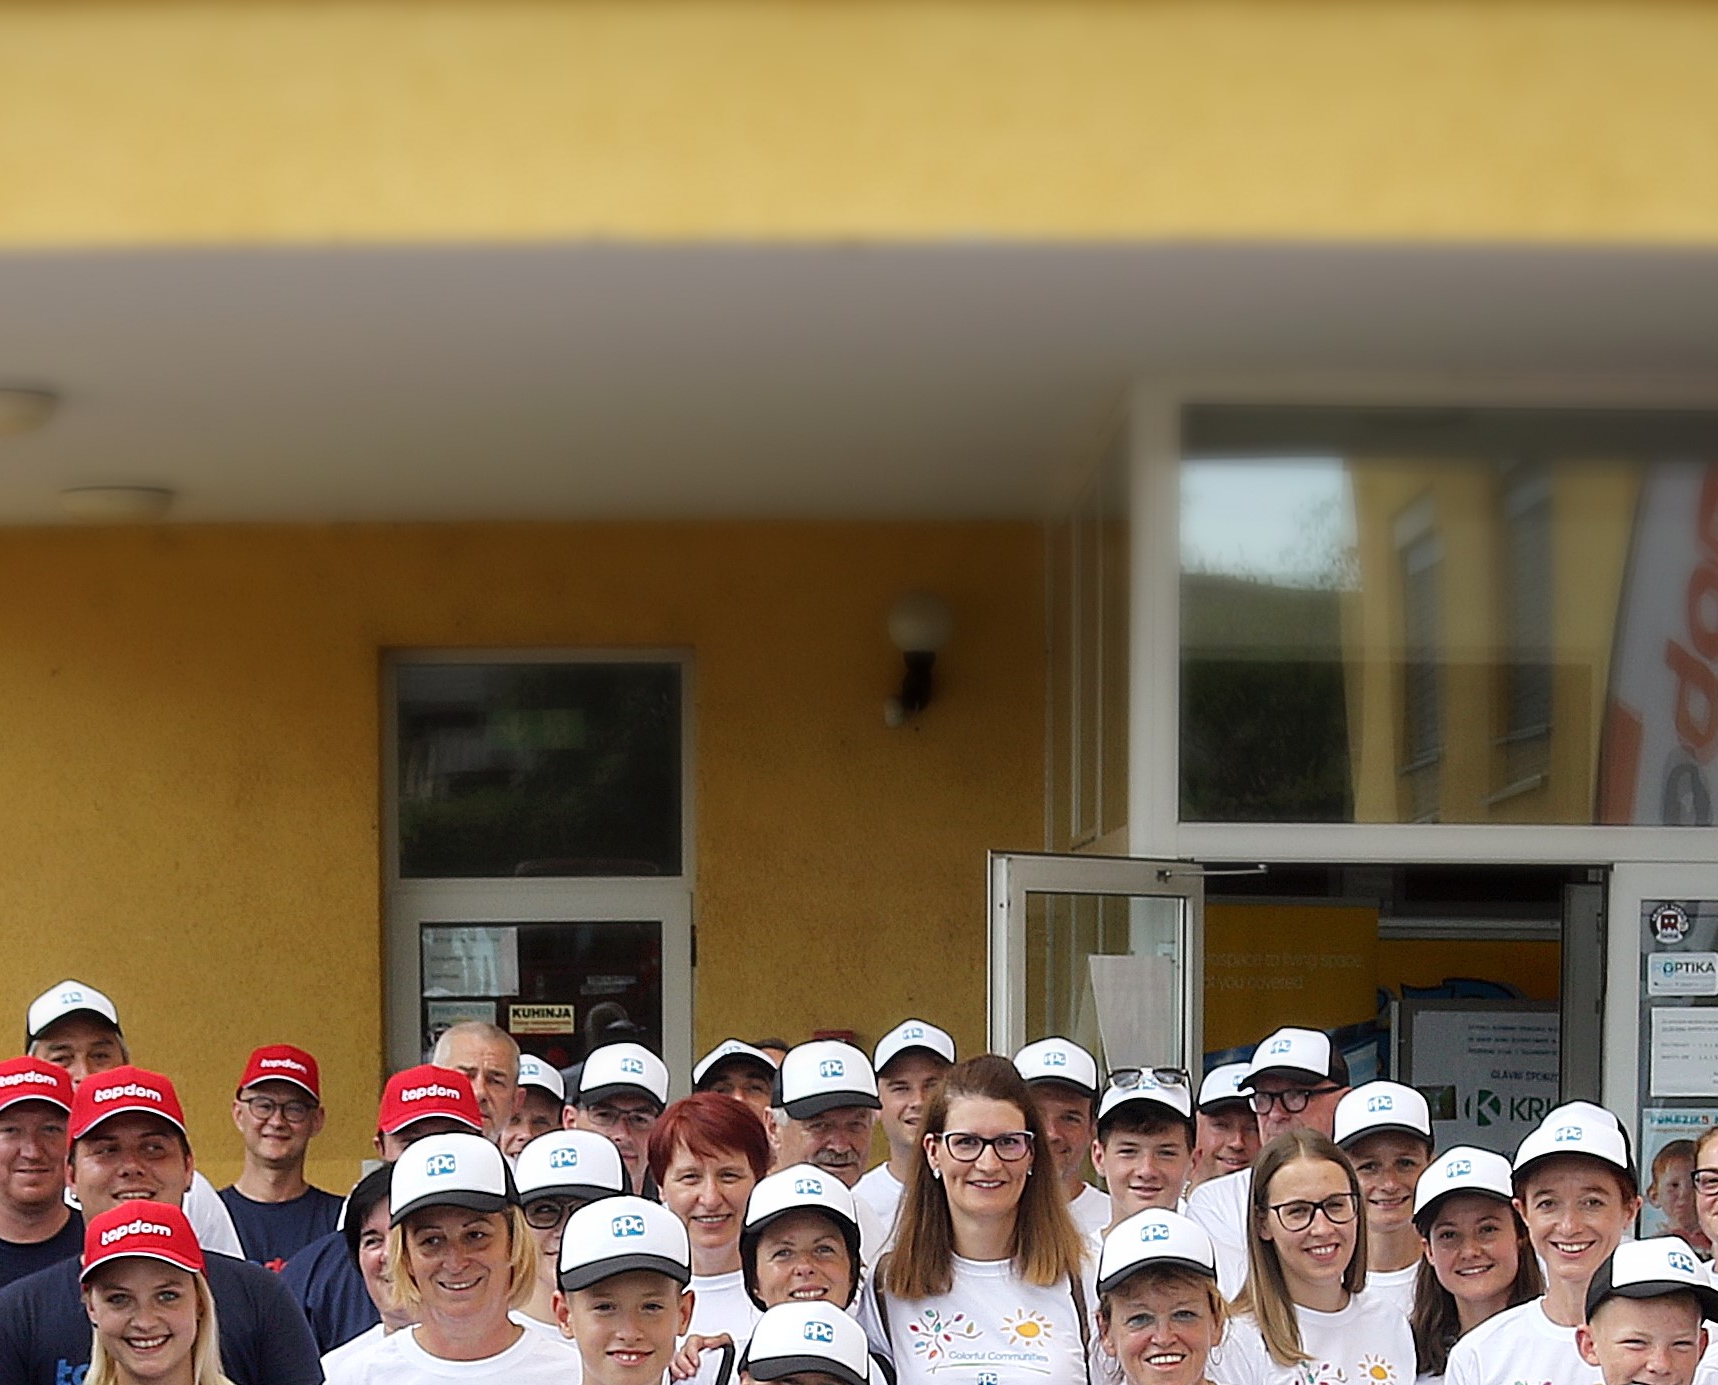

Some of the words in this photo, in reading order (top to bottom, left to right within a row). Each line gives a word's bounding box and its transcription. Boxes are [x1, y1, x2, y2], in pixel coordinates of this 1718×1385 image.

[512, 1007, 572, 1018] KUHINJA
[259, 1057, 307, 1074] topdom
[820, 1060, 845, 1077] PPG
[94, 1082, 162, 1103] topdom
[401, 1083, 461, 1102] topdom
[1368, 1096, 1393, 1112] PPG
[1555, 1126, 1582, 1141] PPG
[427, 1154, 456, 1177] PPG
[550, 1148, 578, 1168] PPG
[1447, 1160, 1472, 1178] PPG
[795, 1178, 823, 1196] PPG
[100, 1219, 172, 1246] topdom
[612, 1215, 645, 1238] PPG
[1141, 1223, 1170, 1242] PPG
[1668, 1252, 1695, 1273] PPG
[804, 1321, 834, 1342] PPG
